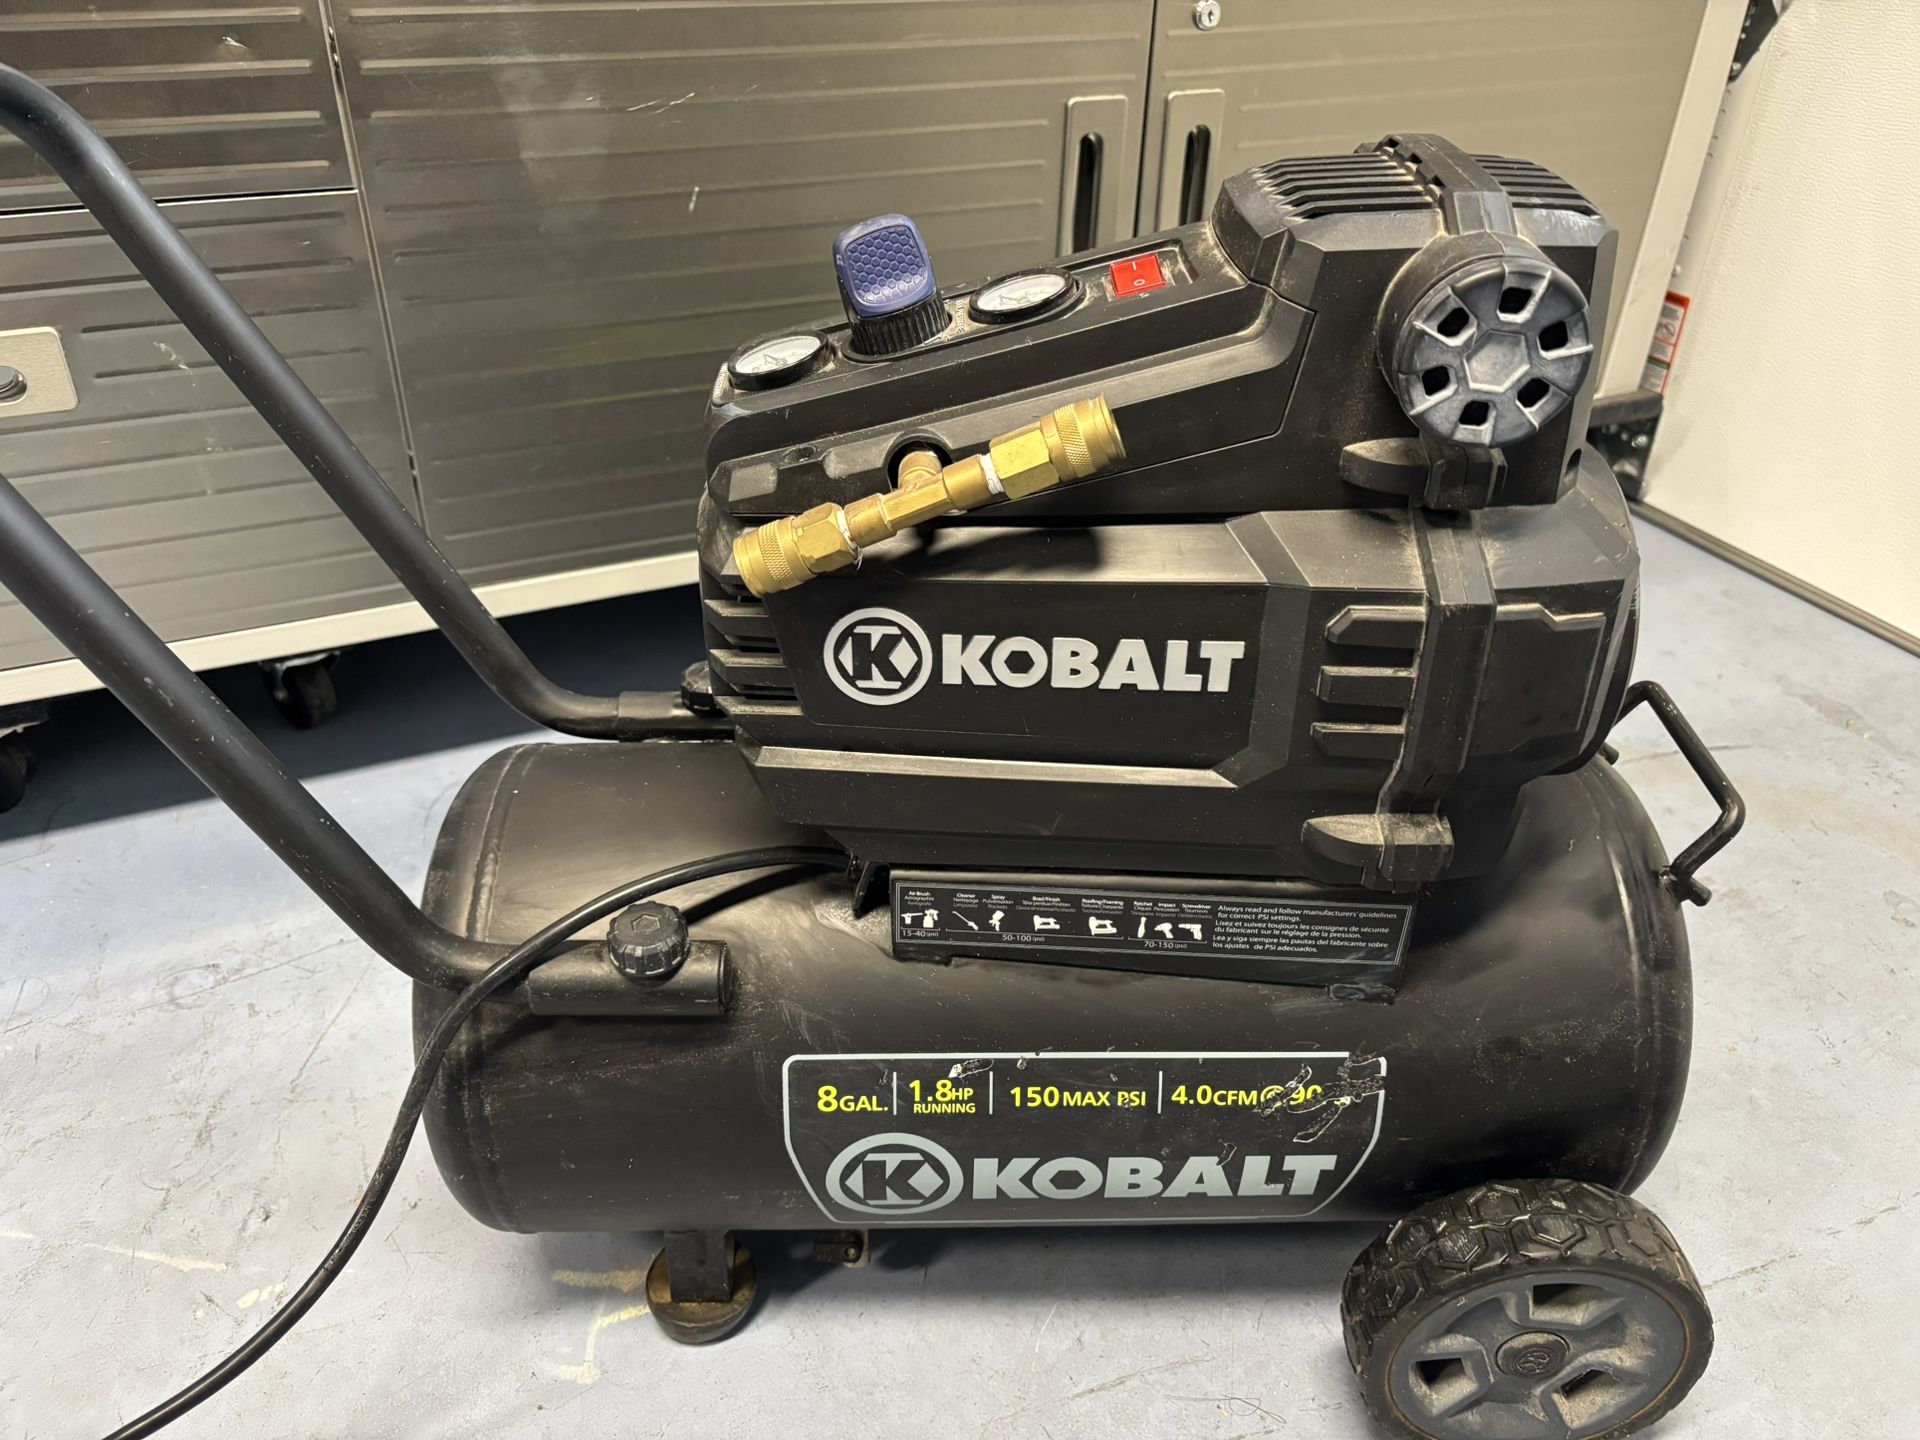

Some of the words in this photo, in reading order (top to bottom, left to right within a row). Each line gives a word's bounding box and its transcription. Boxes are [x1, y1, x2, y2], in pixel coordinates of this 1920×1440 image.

[942, 634, 1245, 692] KOBALT
[1218, 905, 1243, 913] Always
[1359, 911, 1397, 919] guidelines
[1270, 915, 1301, 923] settings.
[1268, 922, 1298, 930] toujours
[1002, 934, 1031, 942] 50-100
[1144, 941, 1174, 949] 70-150
[1276, 944, 1318, 952] adecuados.
[1117, 1091, 1146, 1106] PSI
[913, 1103, 976, 1114] RUNNING
[972, 1153, 1338, 1201] KOBALT
